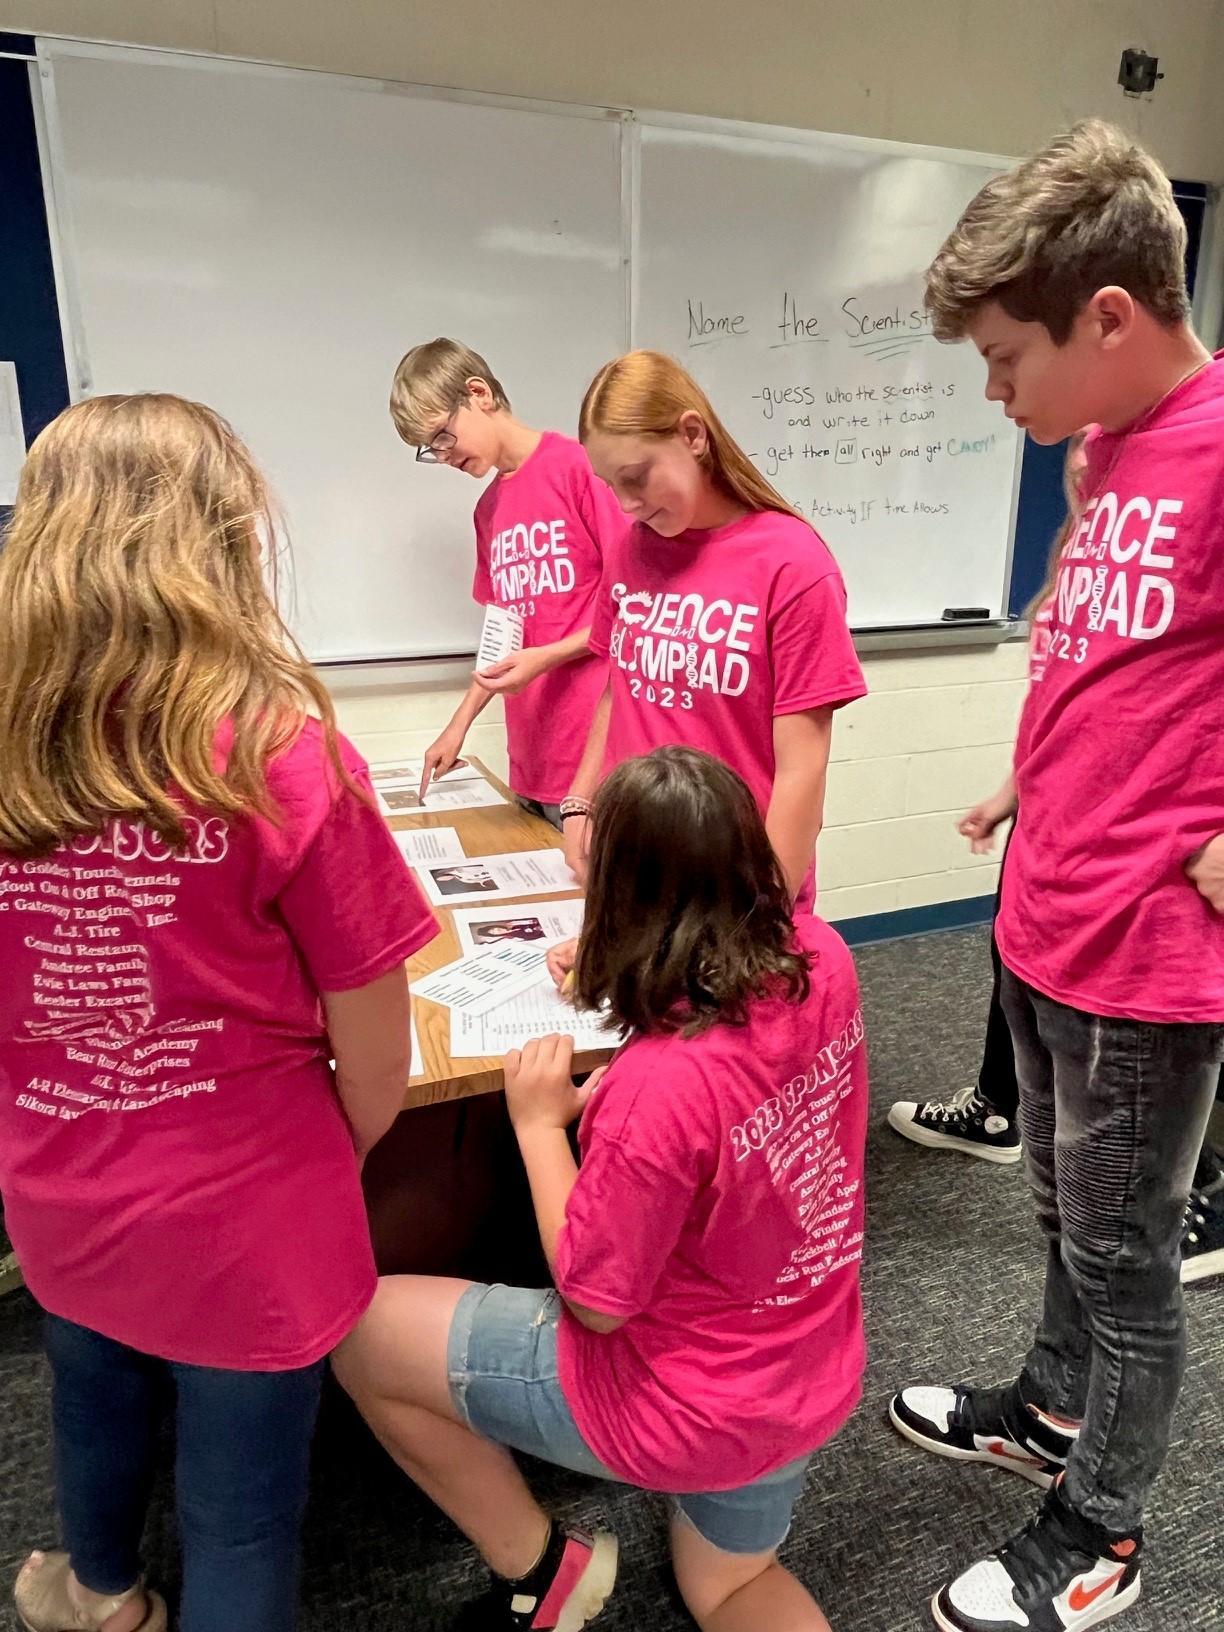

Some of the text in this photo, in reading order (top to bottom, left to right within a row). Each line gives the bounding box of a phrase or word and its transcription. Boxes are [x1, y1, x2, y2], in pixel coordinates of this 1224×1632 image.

[688, 291, 932, 341] Name the Scientist
[825, 388, 852, 403] who
[855, 386, 878, 401] the
[942, 383, 955, 397] is
[788, 408, 935, 429] and write it down
[767, 444, 795, 476] get
[861, 446, 892, 466] right
[899, 443, 920, 458] and
[926, 444, 942, 463] get
[490, 519, 569, 571] CIENCE
[611, 582, 759, 652] SCIENCE
[629, 678, 694, 710] 2023
[73, 865, 123, 881] Touch
[124, 873, 181, 887] ennels
[73, 885, 100, 900] Off
[131, 892, 176, 909] Shop
[84, 924, 122, 938] Tire
[146, 912, 178, 928] Inc.
[96, 957, 147, 974] Family
[133, 1038, 199, 1061] Academy
[730, 1097, 783, 1163] 2023
